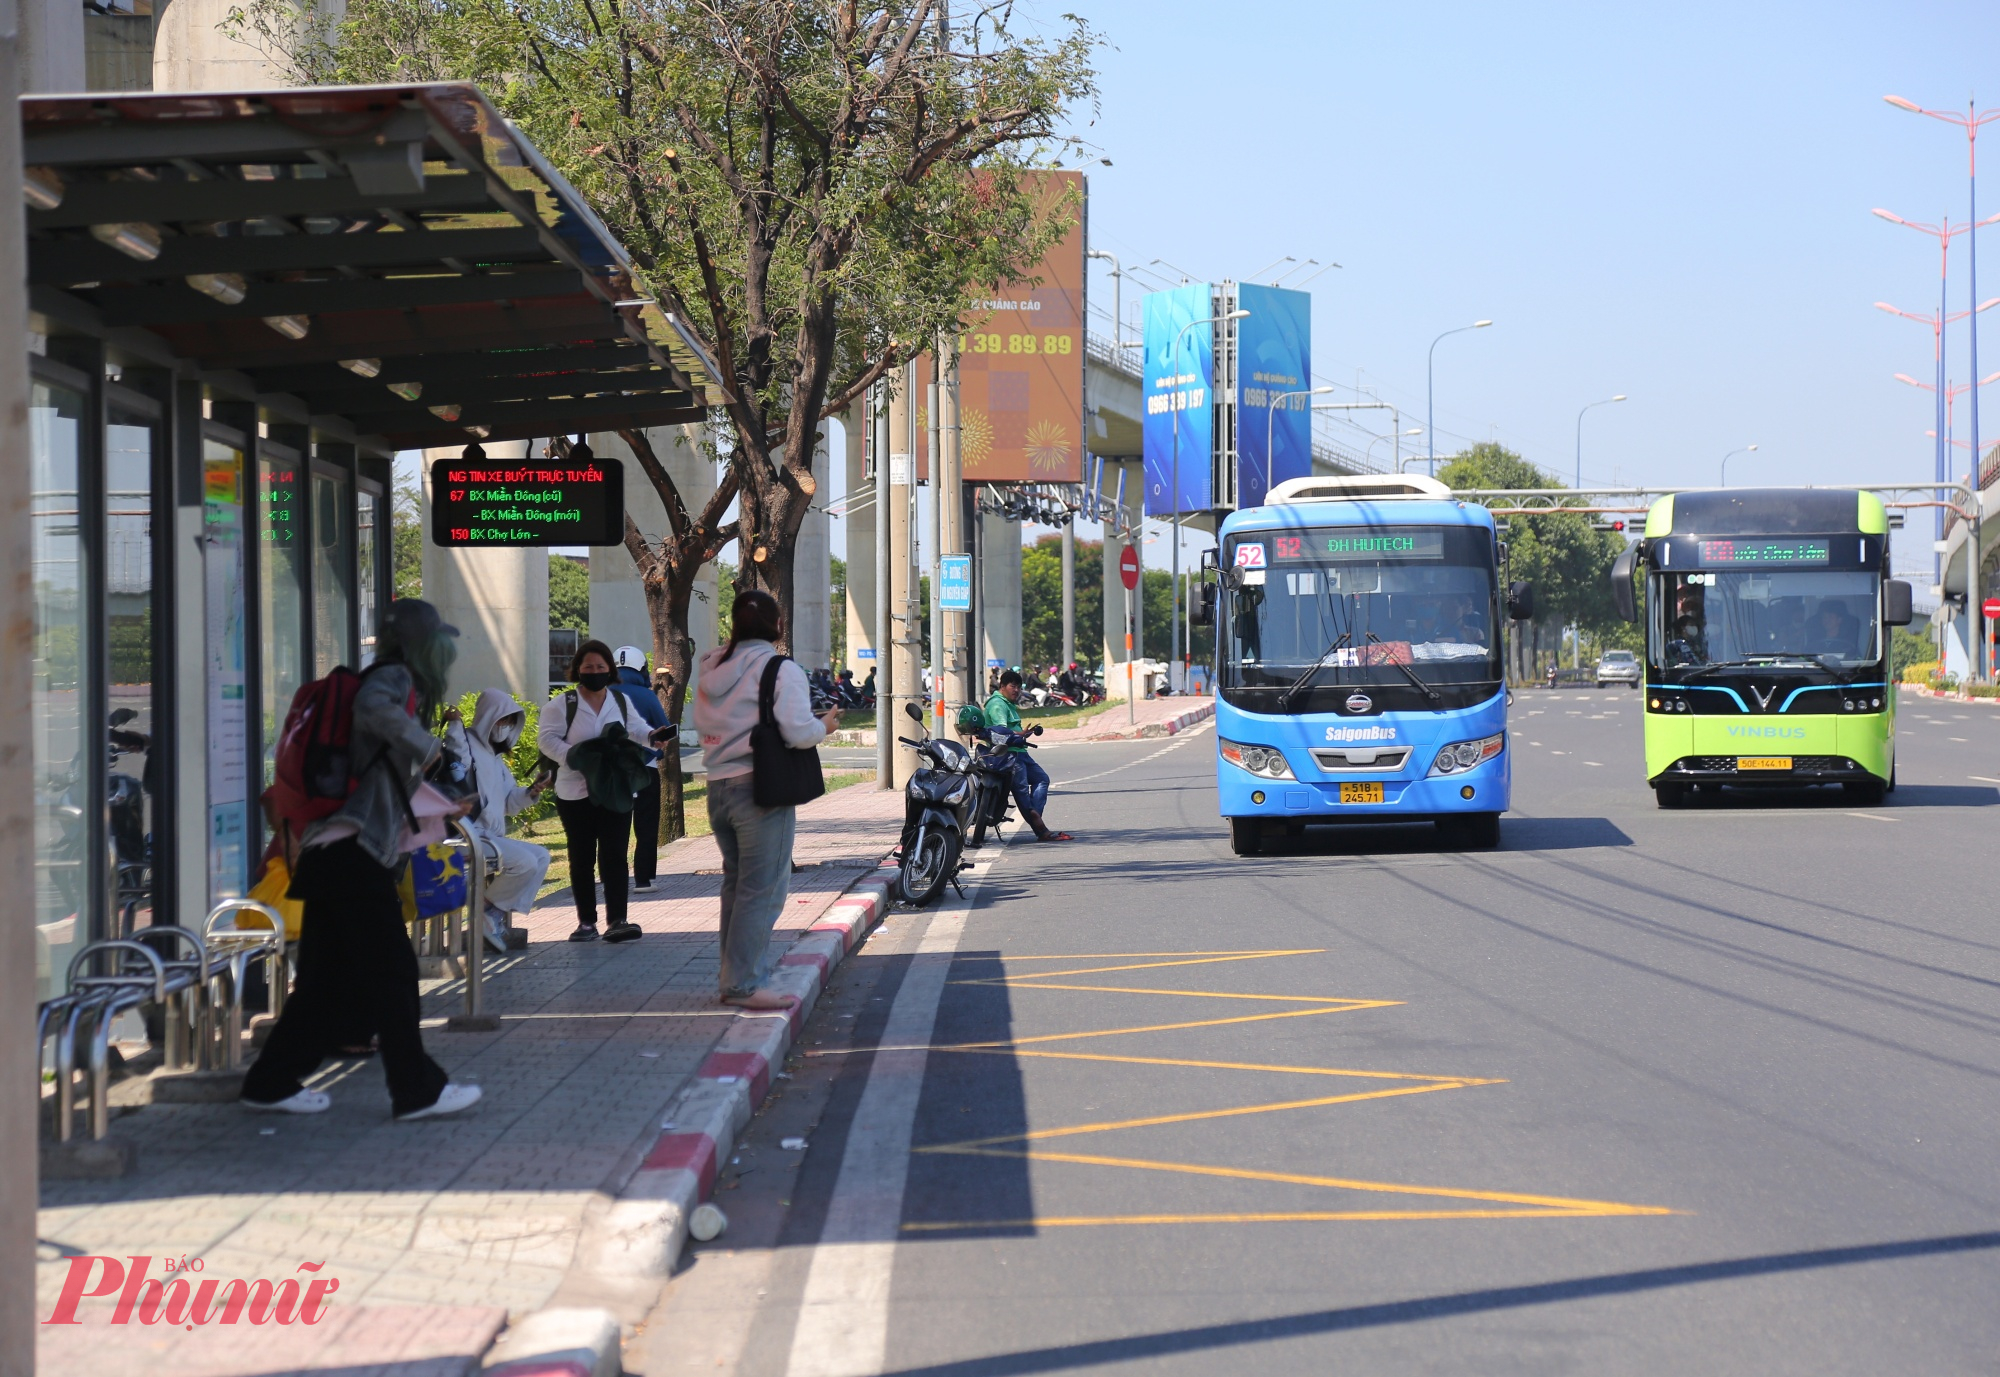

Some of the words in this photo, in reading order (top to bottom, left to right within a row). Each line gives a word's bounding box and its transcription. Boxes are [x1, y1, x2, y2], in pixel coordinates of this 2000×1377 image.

[982, 297, 1018, 311] QUẢNG
[1020, 299, 1041, 311] CÁO
[1148, 393, 1169, 415] 0966
[1188, 388, 1204, 408] 197
[1244, 387, 1267, 408] 0966
[1290, 392, 1307, 412] 197
[448, 471, 467, 482] NG
[469, 471, 486, 482] TIN
[487, 471, 503, 482] XE
[505, 467, 535, 482] BUÝT
[536, 470, 564, 485] TRỰC
[567, 464, 603, 482] TUYẾN
[450, 490, 465, 502] 67
[469, 490, 485, 502] BX
[514, 490, 541, 503] Đông
[542, 490, 563, 503] (cũ)
[481, 509, 496, 521] BX
[525, 509, 552, 522] Đông
[553, 509, 581, 522] (mới)
[450, 528, 469, 540] 150
[470, 528, 486, 540] BX
[487, 528, 509, 541] Chợ
[510, 528, 531, 540] Lớn
[1276, 537, 1301, 558] 52
[1328, 539, 1350, 552] ĐH
[1353, 537, 1414, 551] HUTECH
[1237, 546, 1263, 567] 52
[1325, 726, 1396, 742] SaigonBus
[1727, 726, 1806, 738] VINBUS
[1351, 783, 1371, 793] 51B
[1344, 793, 1378, 803] 245.71
